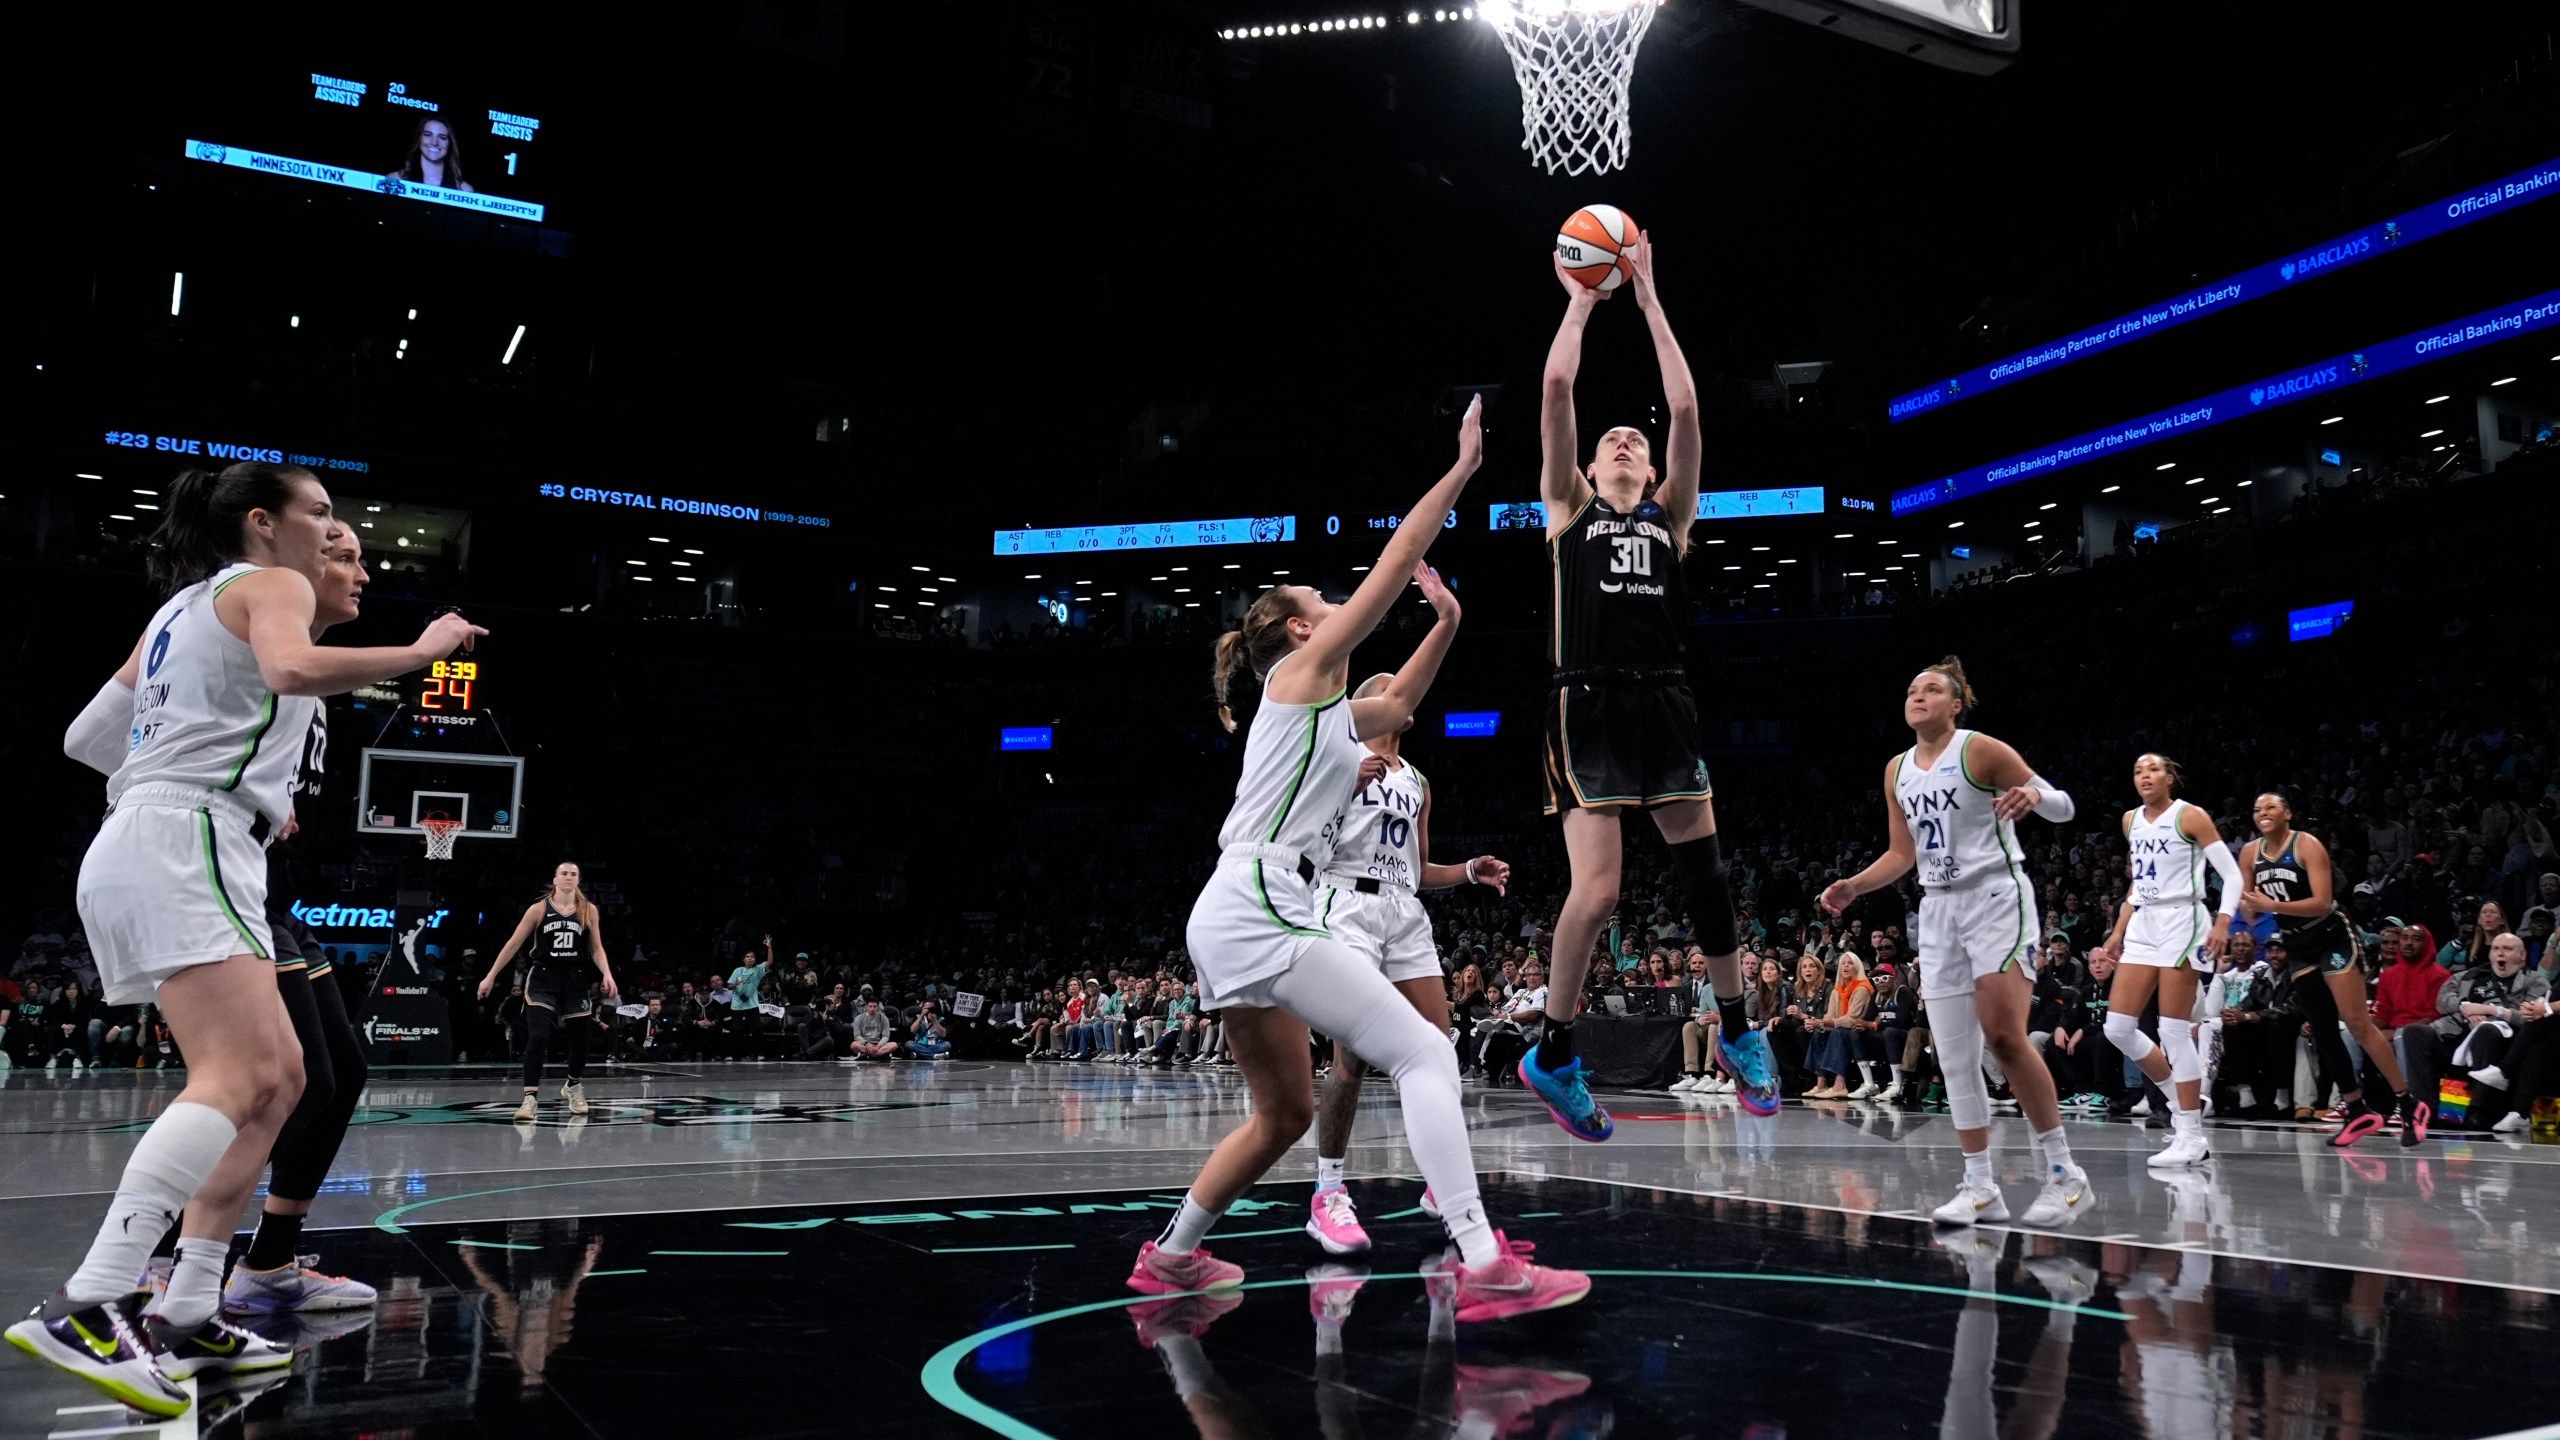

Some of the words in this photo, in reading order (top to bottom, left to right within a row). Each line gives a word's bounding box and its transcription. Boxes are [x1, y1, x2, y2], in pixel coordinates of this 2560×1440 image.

[315, 86, 359, 106] ASSISTS
[389, 82, 404, 94] 20
[388, 92, 438, 112] Ionescu
[492, 122, 532, 141] ASSISTS
[250, 154, 312, 178] MINNESOTA
[316, 166, 345, 183] LYNX
[504, 152, 517, 176] 1
[410, 186, 440, 198] NEW
[443, 191, 479, 206] YORK
[482, 199, 537, 217] LIBERTY
[2448, 187, 2502, 218] Official
[2505, 170, 2560, 198] Bankin
[2298, 236, 2370, 274] BARCLAYS
[1990, 359, 2025, 381] Official
[2026, 344, 2066, 368] Banking
[2068, 333, 2107, 354] Partner
[2109, 324, 2121, 338] of
[2122, 318, 2141, 333] the
[2143, 308, 2168, 327] New
[2170, 299, 2196, 318] York
[2198, 284, 2241, 309] Liberty
[2416, 329, 2464, 355] Official
[2466, 315, 2522, 340] Banking
[2267, 366, 2337, 400] BARCLAYS
[1893, 389, 1940, 417] BARCLAYS
[106, 430, 149, 448] #23
[155, 436, 200, 455] SUE
[207, 442, 283, 464] WICKS
[288, 453, 369, 473] (1997-2002)
[1987, 463, 2018, 482] Official
[2020, 449, 2056, 474] Banking
[2058, 441, 2092, 460] Partner
[2094, 435, 2106, 449] of
[2106, 431, 2124, 446] the
[2125, 424, 2148, 442] New
[2149, 417, 2173, 434] York
[2174, 406, 2212, 429] Liberty
[540, 483, 565, 498] #3
[570, 486, 656, 510] CRYSTAL
[661, 497, 760, 521] ROBINSON
[764, 510, 830, 528] (1999-2005)
[1740, 493, 1758, 502] REB
[1782, 490, 1800, 500] AST
[1842, 497, 1860, 508] 8:10
[1862, 501, 1875, 512] PM
[1008, 531, 1024, 540] AST
[1045, 530, 1062, 539] REB
[1084, 528, 1095, 537] FT
[1120, 526, 1136, 536] 3PT
[1159, 525, 1171, 534] FG
[1326, 516, 1340, 536] 0
[1368, 518, 1385, 529] 1st
[1586, 520, 1626, 541] NEW
[1012, 542, 1020, 552] 0
[1610, 536, 1651, 576] 30
[1626, 583, 1664, 596] Webull
[147, 608, 184, 680] 6
[432, 660, 478, 680] 8:39
[422, 678, 472, 711] 24
[430, 715, 477, 726] TISSOT
[492, 824, 510, 832] AT&T
[1380, 812, 1409, 849] 10
[1918, 818, 1946, 850] 21
[1374, 852, 1408, 873] MAYO
[2134, 858, 2156, 880] 24
[1368, 866, 1412, 888] CLINIC
[2262, 882, 2290, 902] 44
[544, 920, 562, 934] NEW
[554, 932, 574, 948] 20
